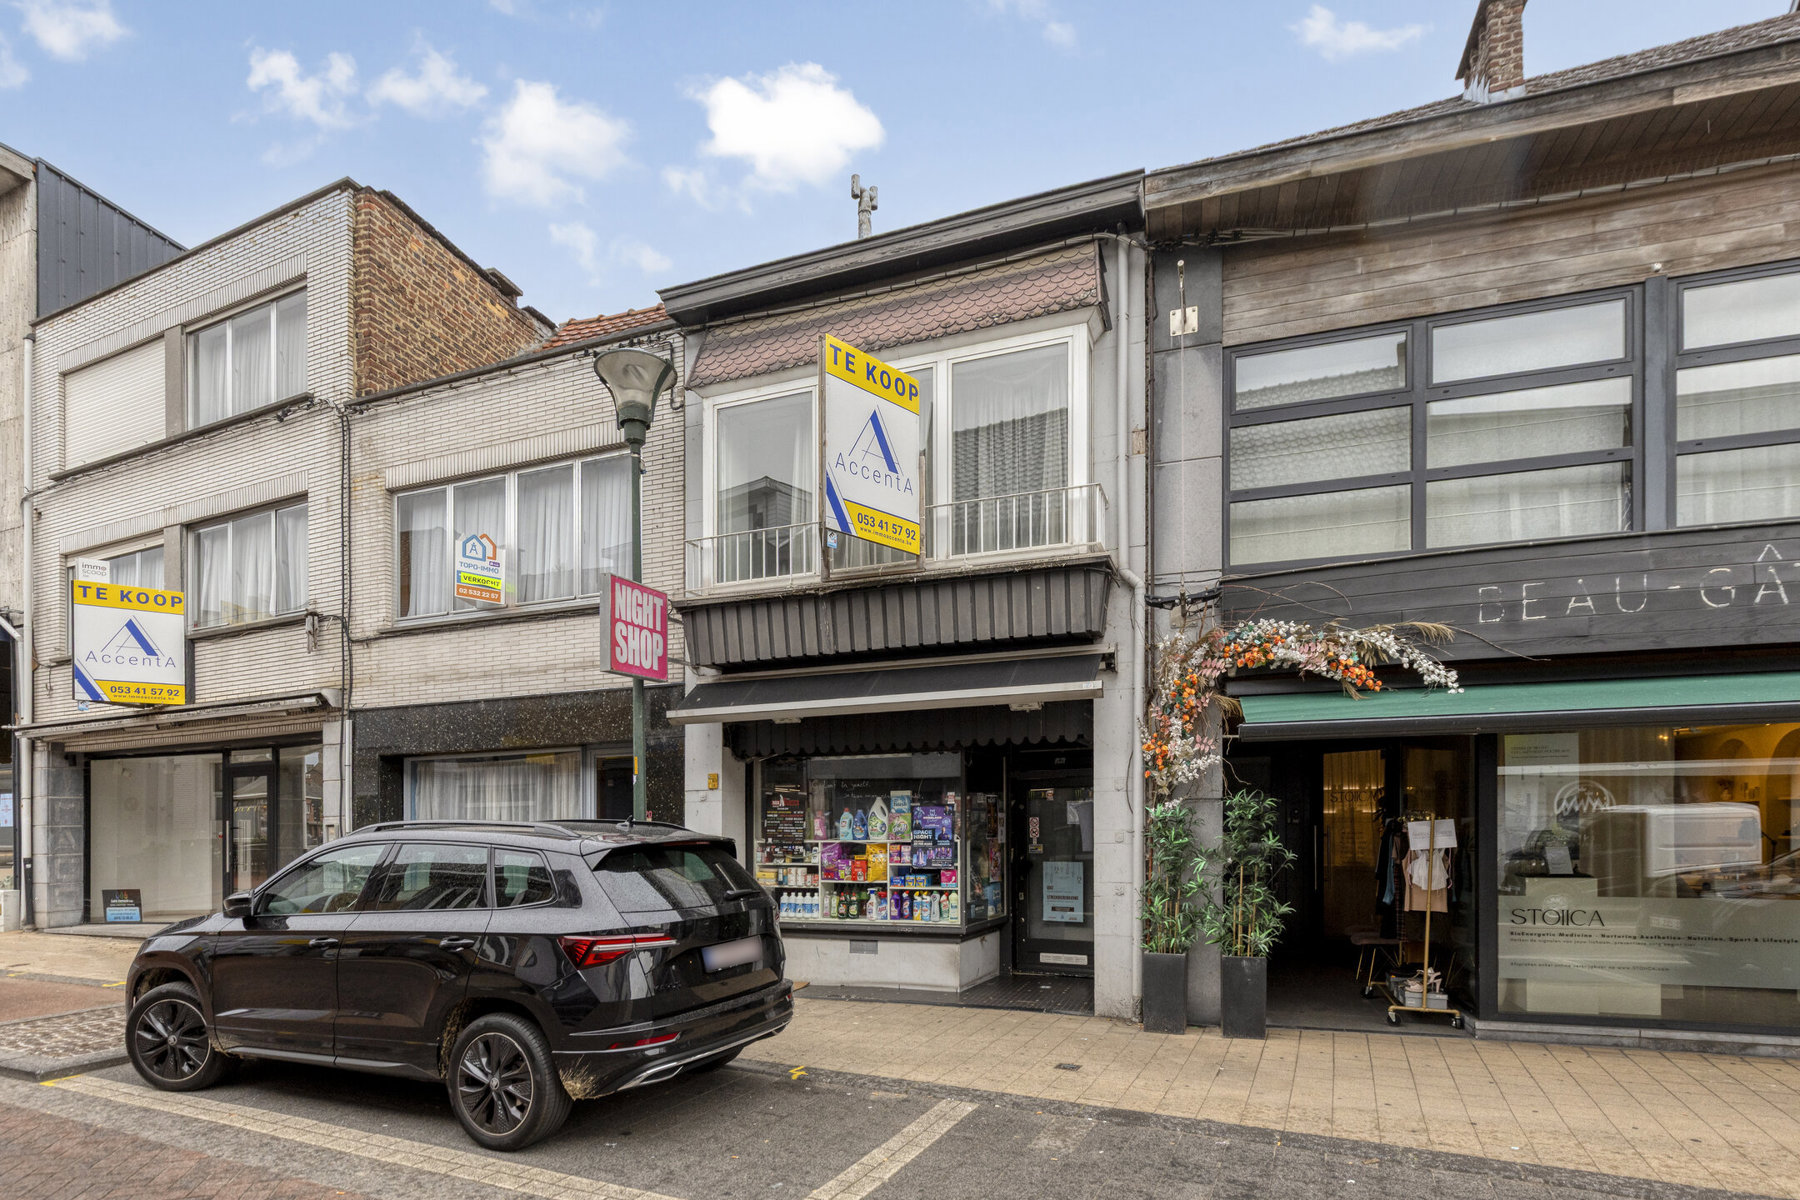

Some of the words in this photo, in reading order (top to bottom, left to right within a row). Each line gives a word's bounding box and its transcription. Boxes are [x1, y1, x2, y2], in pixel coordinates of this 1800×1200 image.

[829, 343, 856, 374] TE
[866, 361, 919, 401] KOOP
[835, 452, 914, 497] AccentA
[857, 512, 876, 528] 053
[877, 517, 889, 533] 41
[890, 522, 904, 536] 57
[905, 526, 916, 541] 92
[459, 561, 499, 574] TOPO-IMMO
[463, 574, 500, 587] VERKOCHT
[78, 585, 108, 600] TE
[119, 590, 182, 607] KOOP
[615, 582, 664, 631] NIGHT
[615, 621, 664, 671] SHOP
[85, 650, 176, 668] AccentA
[110, 685, 131, 694] 053
[134, 687, 147, 695] 41
[150, 688, 164, 696] 57
[166, 689, 180, 697] 92
[1511, 908, 1605, 927] STOIICA
